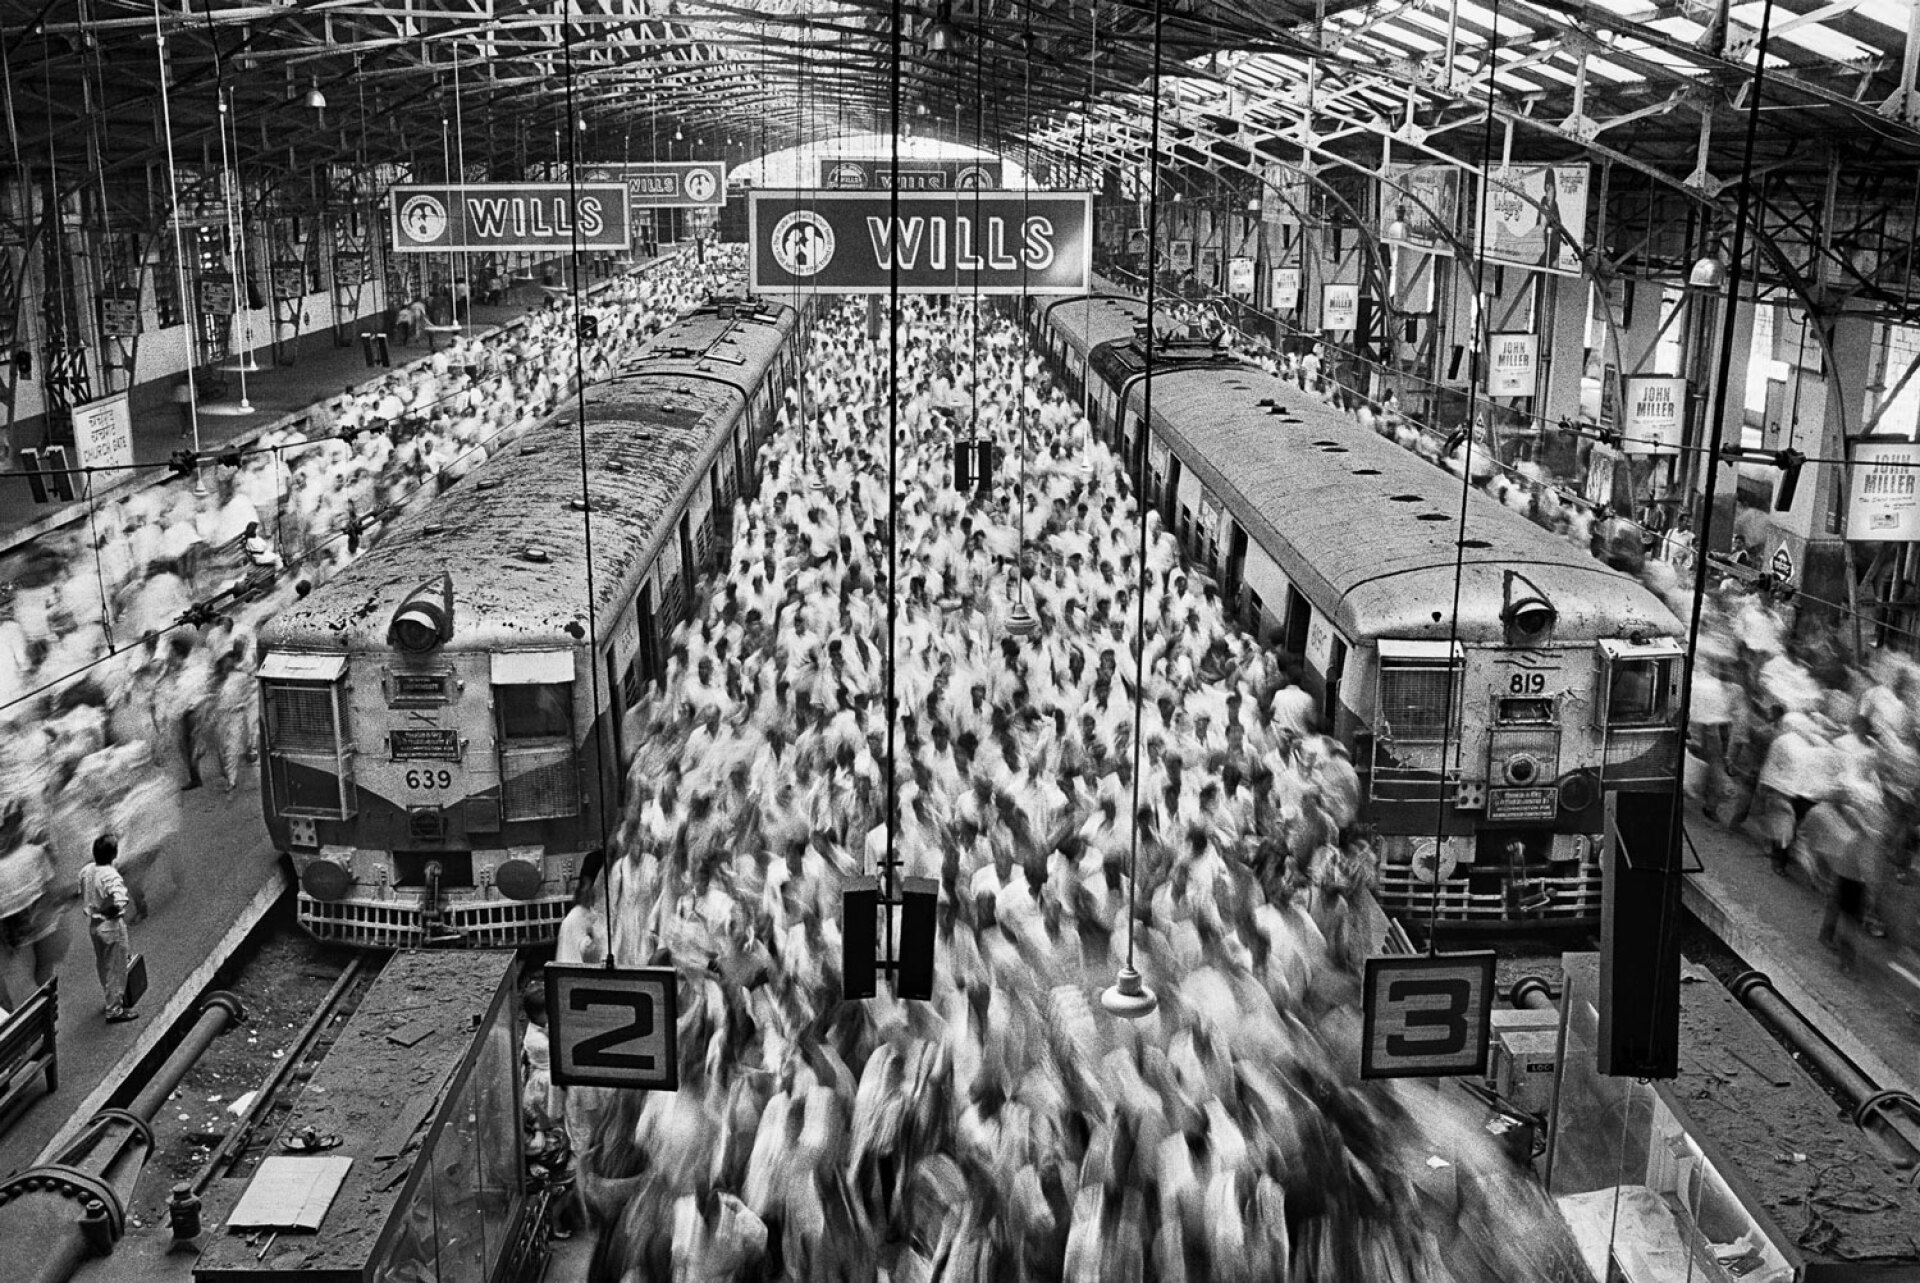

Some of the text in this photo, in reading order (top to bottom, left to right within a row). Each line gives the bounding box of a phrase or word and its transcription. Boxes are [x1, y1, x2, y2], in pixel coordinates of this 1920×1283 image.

[467, 196, 604, 238] WILLS
[866, 216, 1054, 270] WILLS
[1503, 341, 1526, 354] JOHN
[1498, 354, 1529, 367] MILLER
[1642, 386, 1671, 402] JOHN
[1636, 402, 1675, 417] MILLER
[1873, 454, 1911, 474] JOHN
[1864, 474, 1916, 494] MILLER
[1510, 673, 1545, 694] 819
[406, 769, 451, 790] 639
[1386, 979, 1471, 1056] 3
[569, 989, 655, 1068] 2
